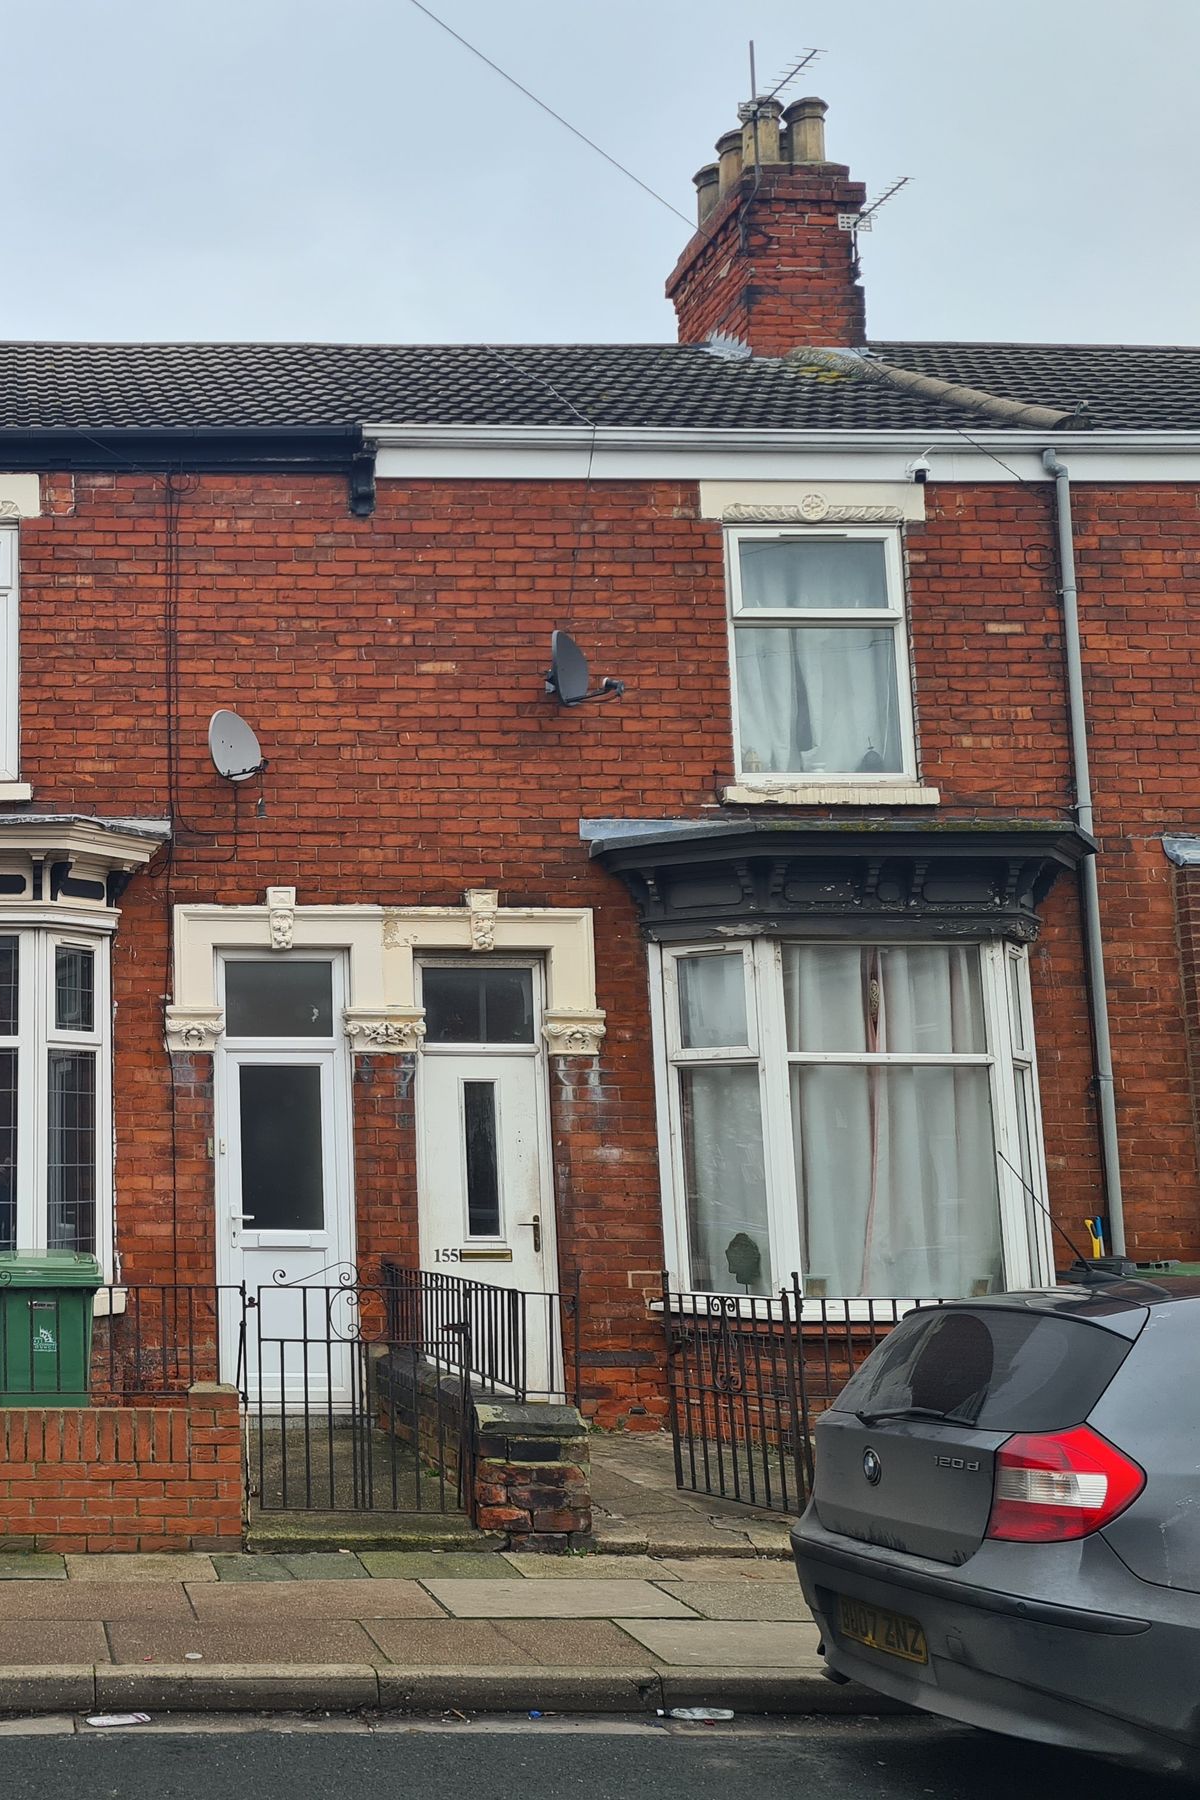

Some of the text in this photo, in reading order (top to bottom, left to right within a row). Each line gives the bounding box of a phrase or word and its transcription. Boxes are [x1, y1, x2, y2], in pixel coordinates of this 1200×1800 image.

[434, 1249, 459, 1262] 155
[933, 1455, 980, 1471] 120d
[883, 1615, 923, 1656] ZNZ
